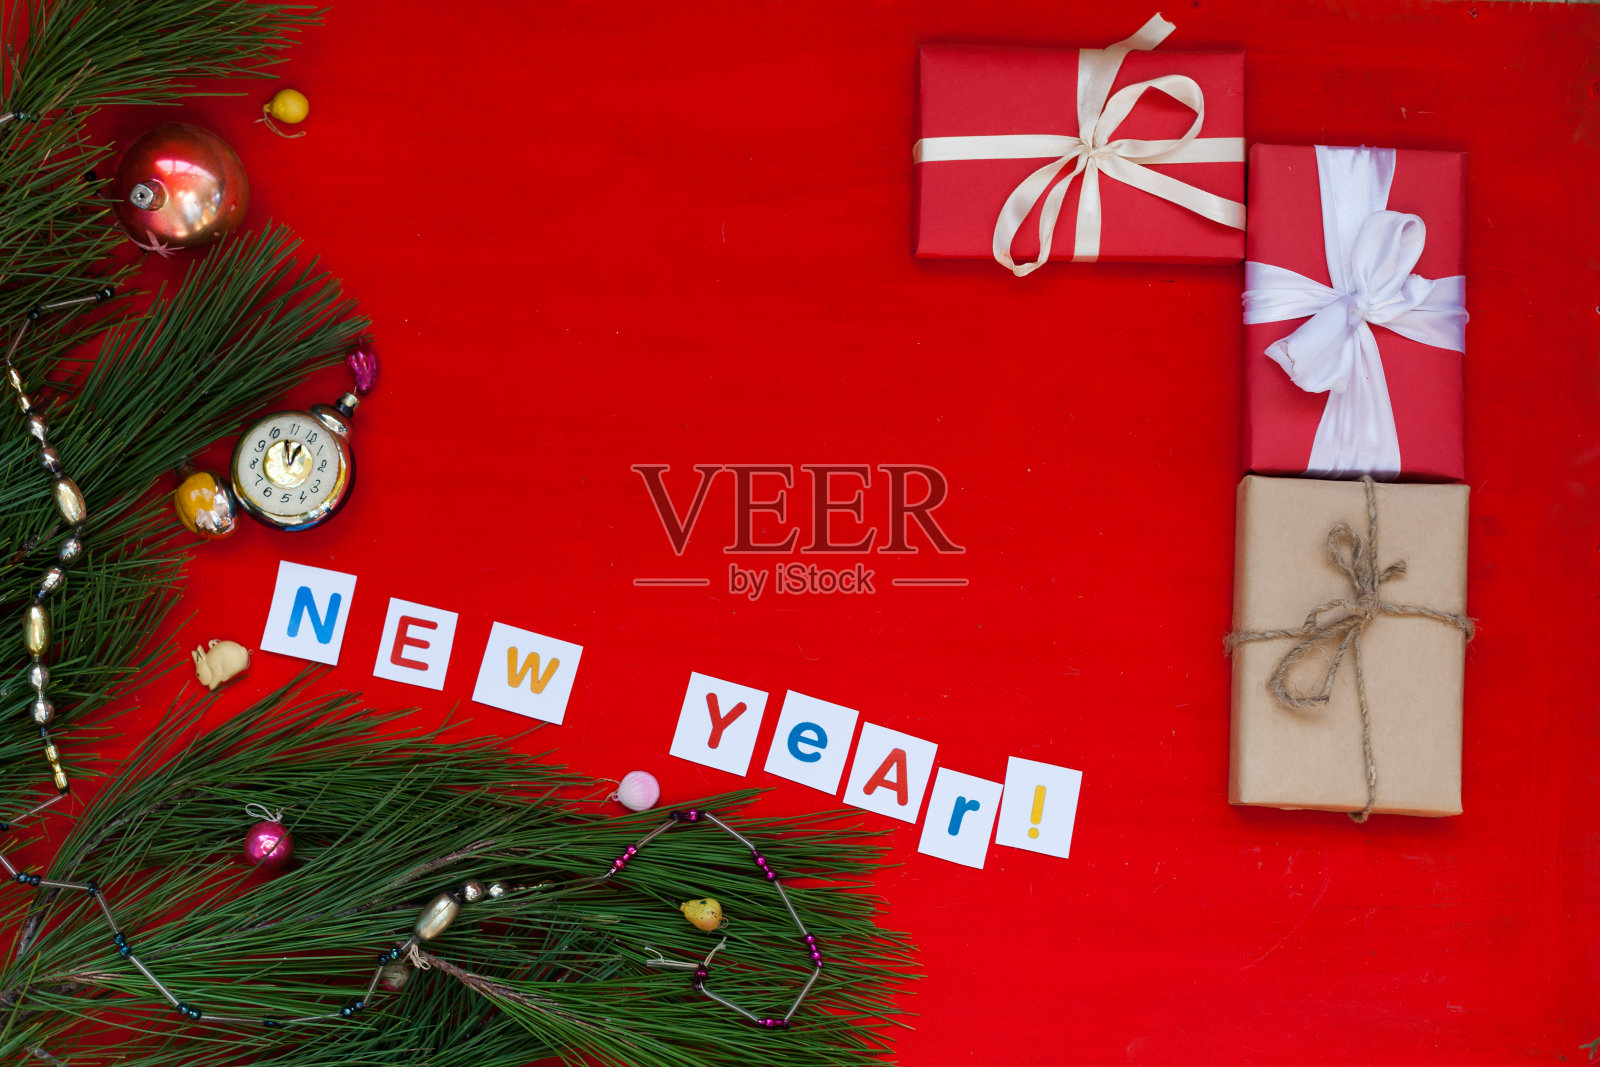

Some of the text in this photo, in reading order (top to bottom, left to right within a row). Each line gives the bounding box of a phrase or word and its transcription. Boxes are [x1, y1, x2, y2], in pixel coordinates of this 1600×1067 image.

[269, 426, 281, 439] 10
[290, 423, 301, 436] 11
[305, 430, 318, 445] 12
[254, 440, 266, 453] 9
[317, 445, 324, 456] 1
[250, 458, 259, 470] 8
[317, 459, 328, 472] 2
[255, 473, 264, 487] 7
[310, 479, 321, 494] 3
[263, 486, 273, 498] 6
[280, 493, 292, 503] 5
[299, 491, 308, 504] 4
